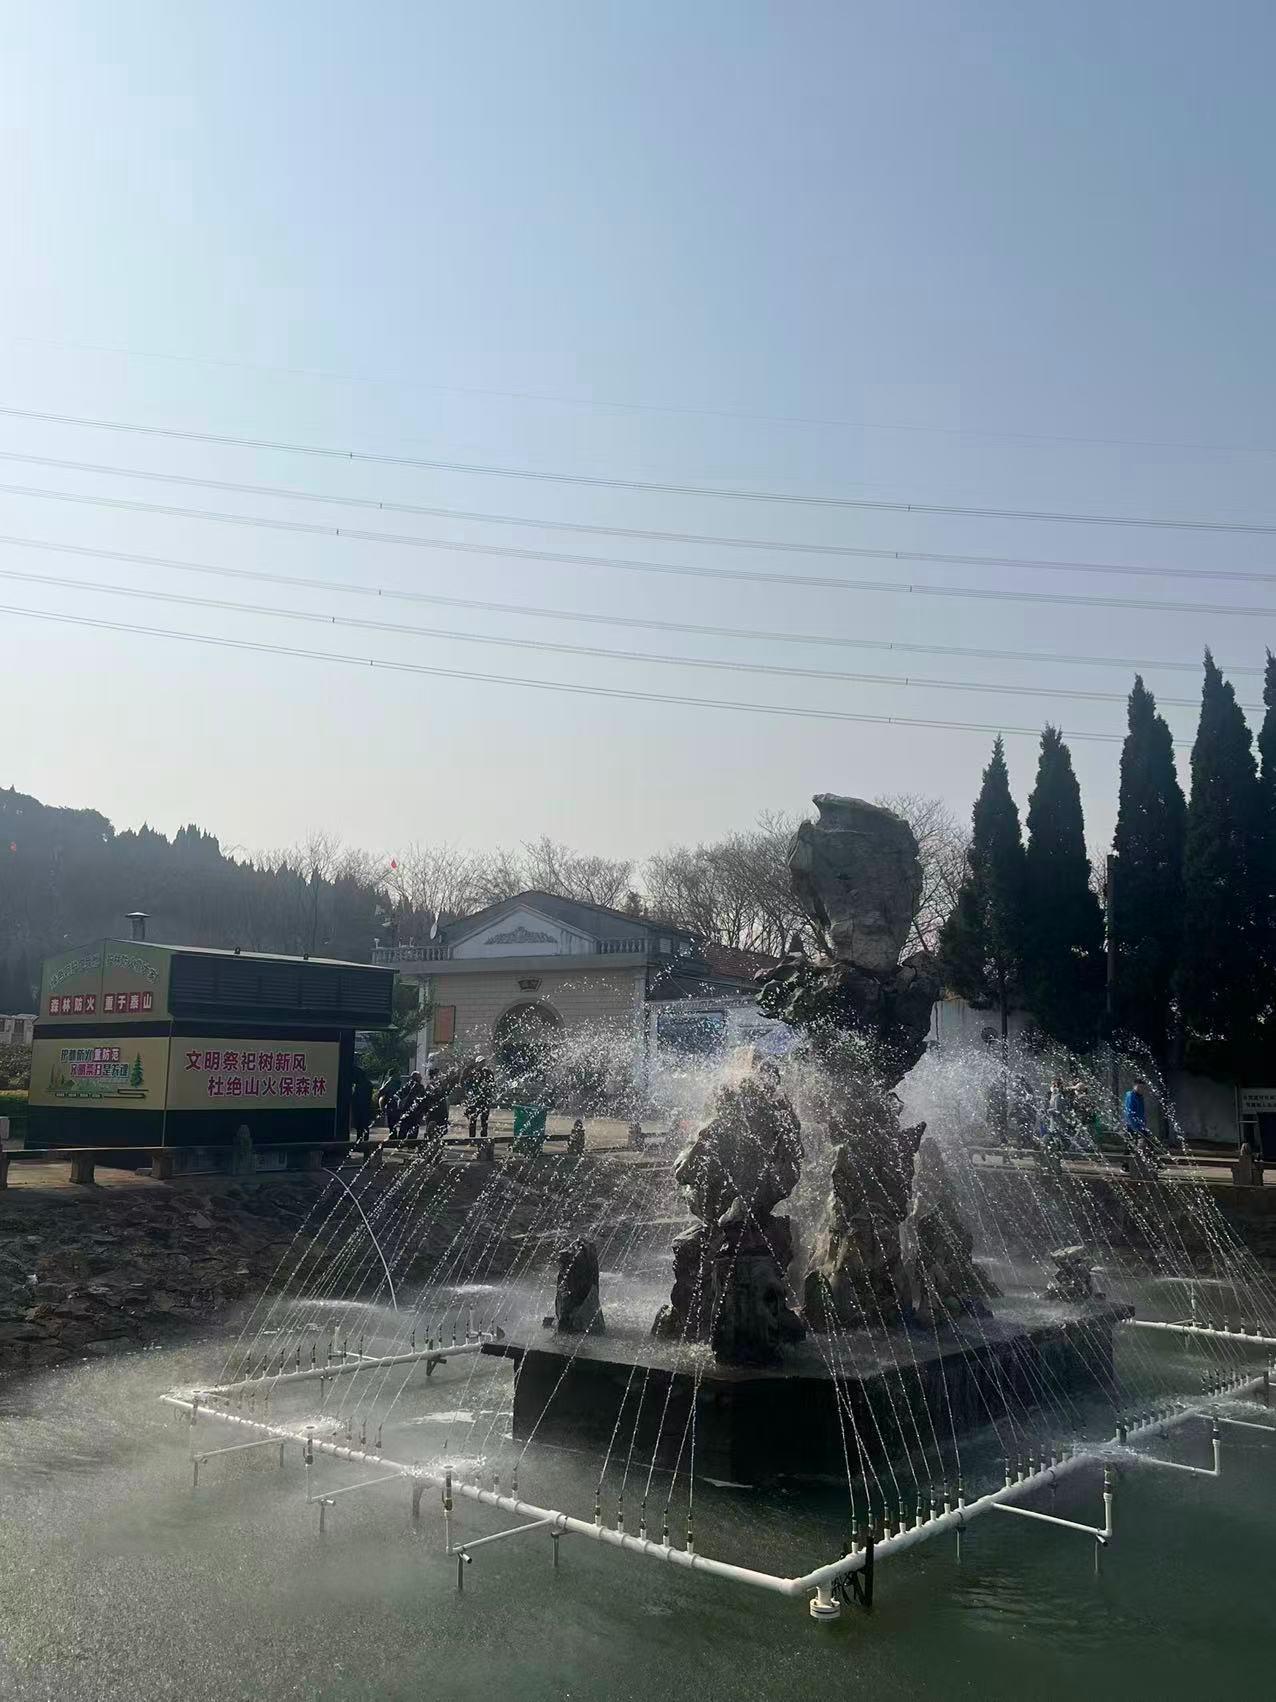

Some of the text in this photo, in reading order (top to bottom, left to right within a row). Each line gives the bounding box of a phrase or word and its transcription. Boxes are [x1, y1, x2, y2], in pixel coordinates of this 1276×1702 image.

[50, 994, 152, 1013] 森林防火 重于泰山
[185, 1050, 307, 1072] 文明祭祀树新风
[207, 1076, 327, 1097] 杜绝山火保森林
